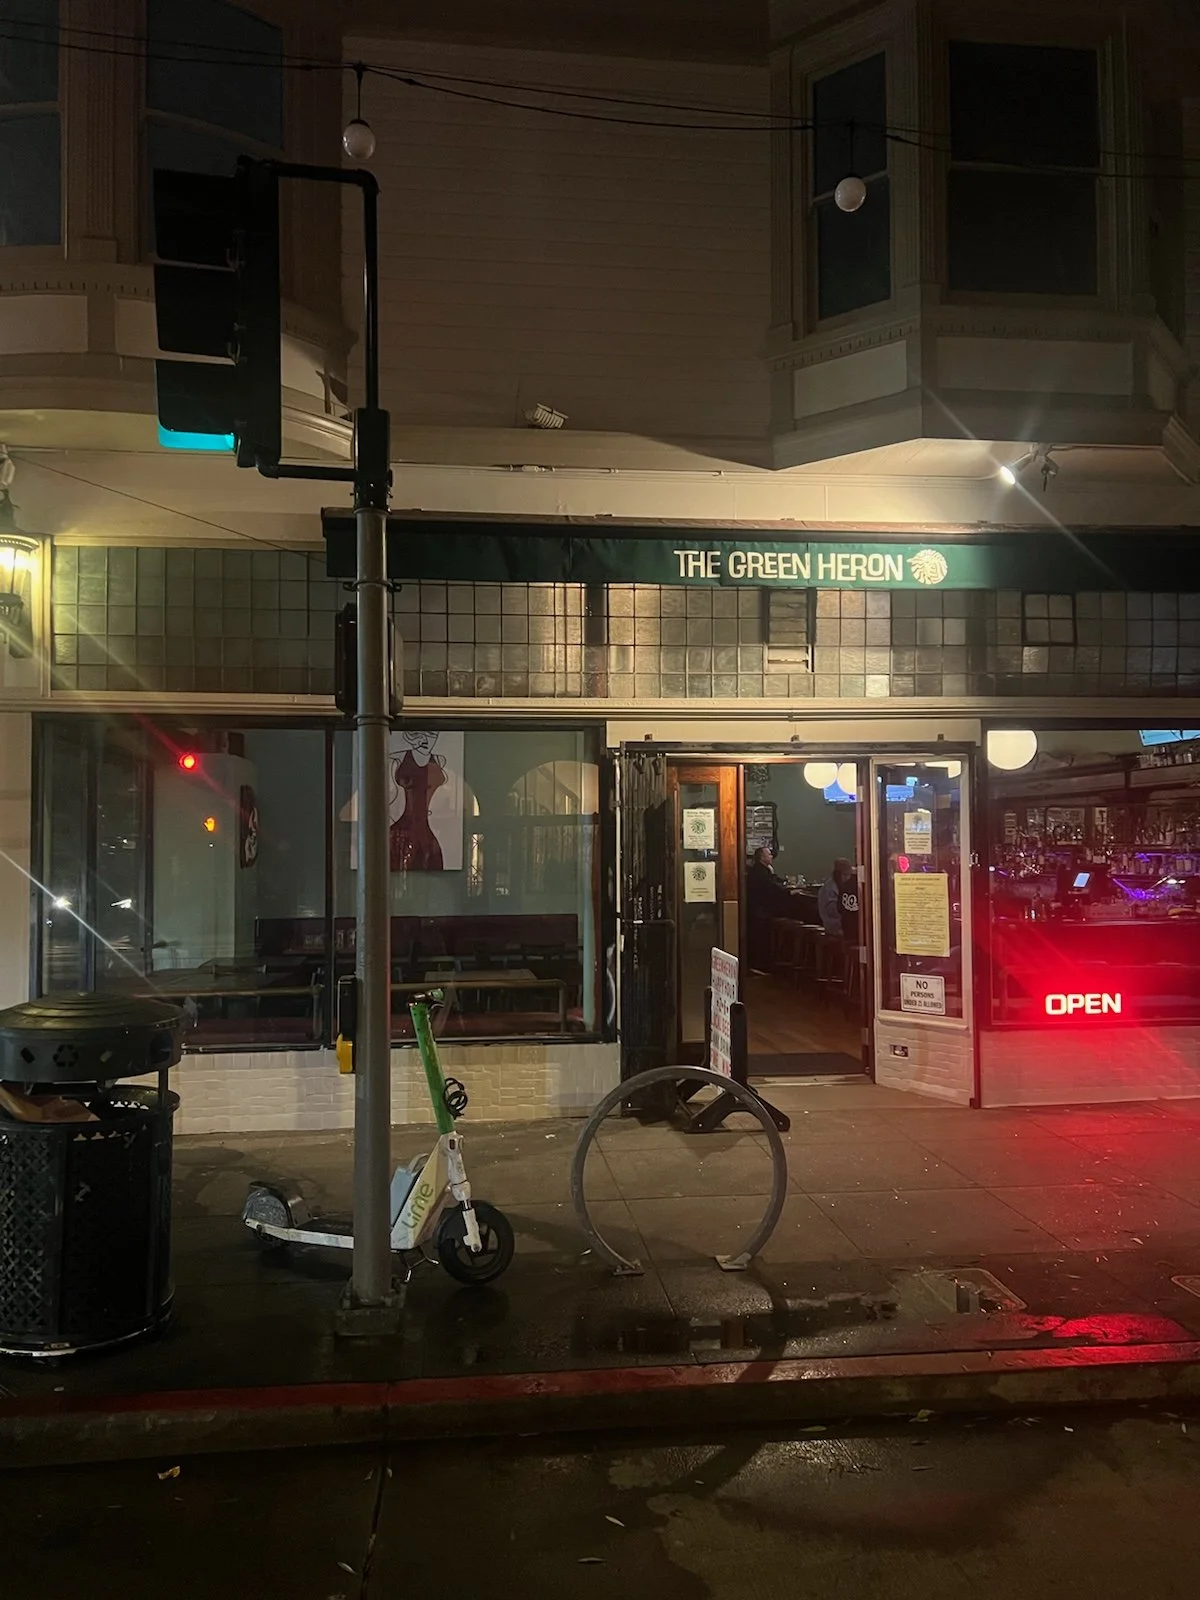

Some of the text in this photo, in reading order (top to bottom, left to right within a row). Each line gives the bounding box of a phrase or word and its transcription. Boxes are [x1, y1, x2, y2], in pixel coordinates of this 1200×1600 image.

[673, 549, 904, 581] THE GREEN HERON
[910, 991, 935, 999] PERSONS
[916, 980, 929, 990] NO
[1045, 993, 1122, 1015] OPEN
[401, 1183, 434, 1229] Lime
